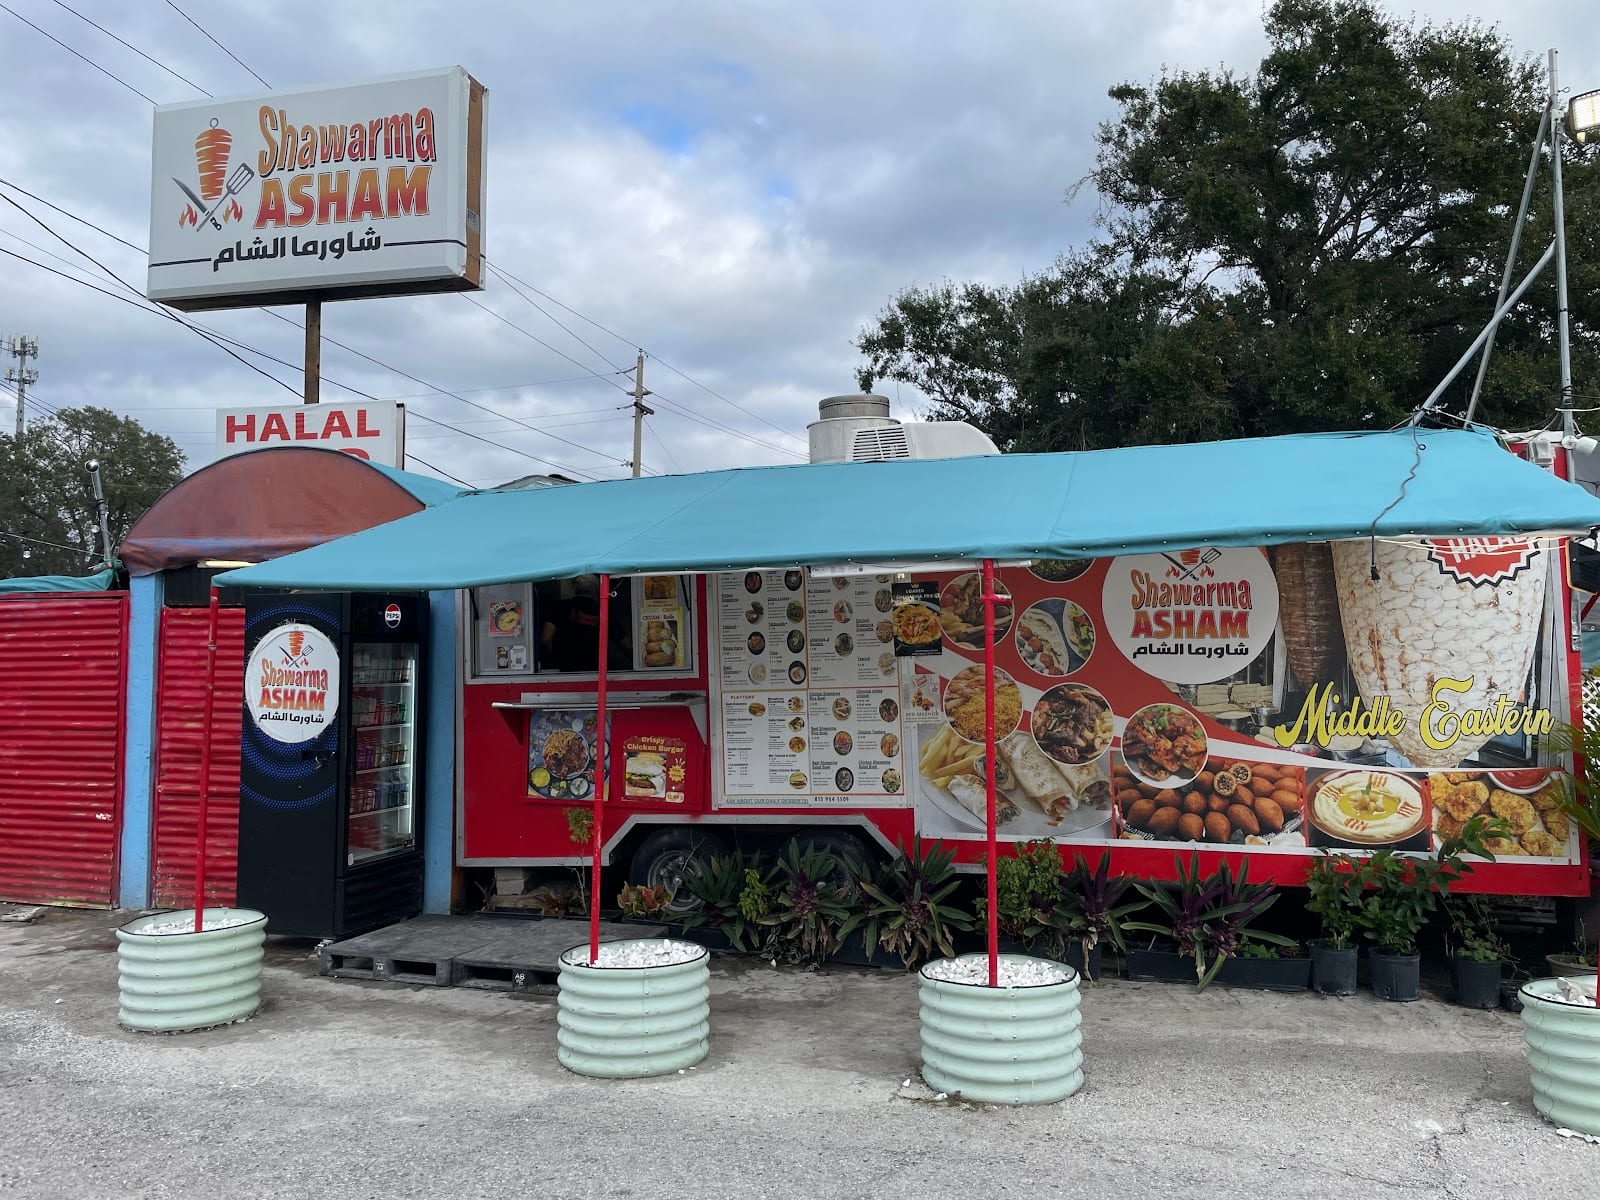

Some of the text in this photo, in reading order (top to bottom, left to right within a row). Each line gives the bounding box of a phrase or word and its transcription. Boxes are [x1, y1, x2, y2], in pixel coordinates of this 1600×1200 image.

[257, 105, 437, 178] Shawarma
[253, 165, 433, 229] ASHAM
[212, 226, 381, 272] شاورما الشام
[226, 409, 380, 443] HALAL
[1130, 569, 1253, 610] Shawarma
[1130, 609, 1250, 639] ASHAM
[1132, 642, 1249, 658] شاورما الشام
[260, 658, 329, 691] Shawarma
[258, 688, 326, 711] ASHAM
[1274, 675, 1556, 751] Middle Eastern
[259, 711, 324, 725] شاورما الشام
[626, 743, 685, 754] Chicken Burger
[641, 736, 665, 744] Crispy
